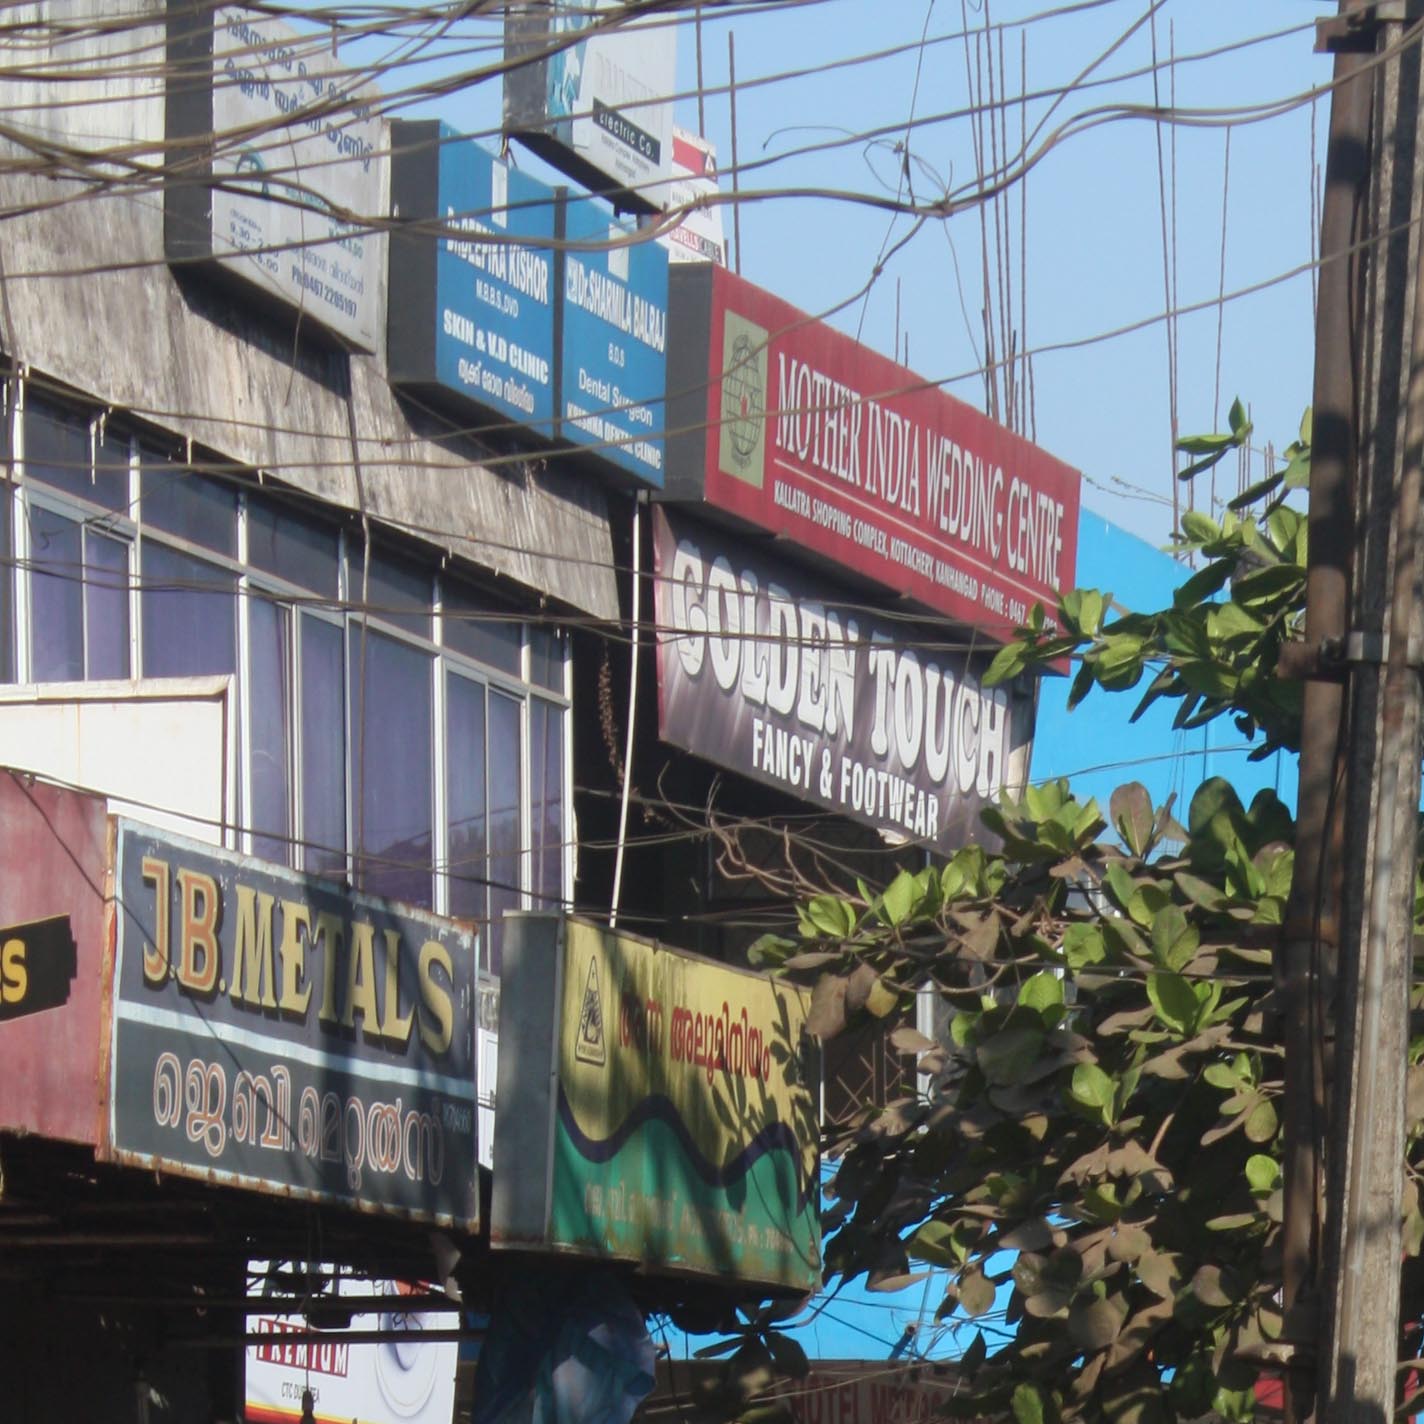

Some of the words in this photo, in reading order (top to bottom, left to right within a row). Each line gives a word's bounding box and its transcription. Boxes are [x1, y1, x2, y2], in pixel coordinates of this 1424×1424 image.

[443, 308, 474, 347] SKIN
[475, 329, 486, 352] &
[508, 343, 549, 384] CLINIC
[633, 294, 666, 354] BALRAJ
[578, 367, 611, 404] Dental
[634, 440, 662, 470] CLINIC
[775, 352, 861, 488] MOTHER
[864, 400, 921, 518] INDIA
[925, 428, 1004, 561] WEDDING
[1006, 476, 1065, 593] CENTRE
[774, 479, 812, 519] KALLATRA
[812, 497, 852, 539] SHOPPING
[673, 540, 860, 745] GOLDEN
[868, 626, 1012, 806] TOUCH
[752, 717, 815, 790] FANCY
[819, 748, 833, 800] &
[840, 755, 941, 842] FOOTWEAR
[0, 938, 28, 1003] S
[257, 1317, 350, 1378] PREMIUM
